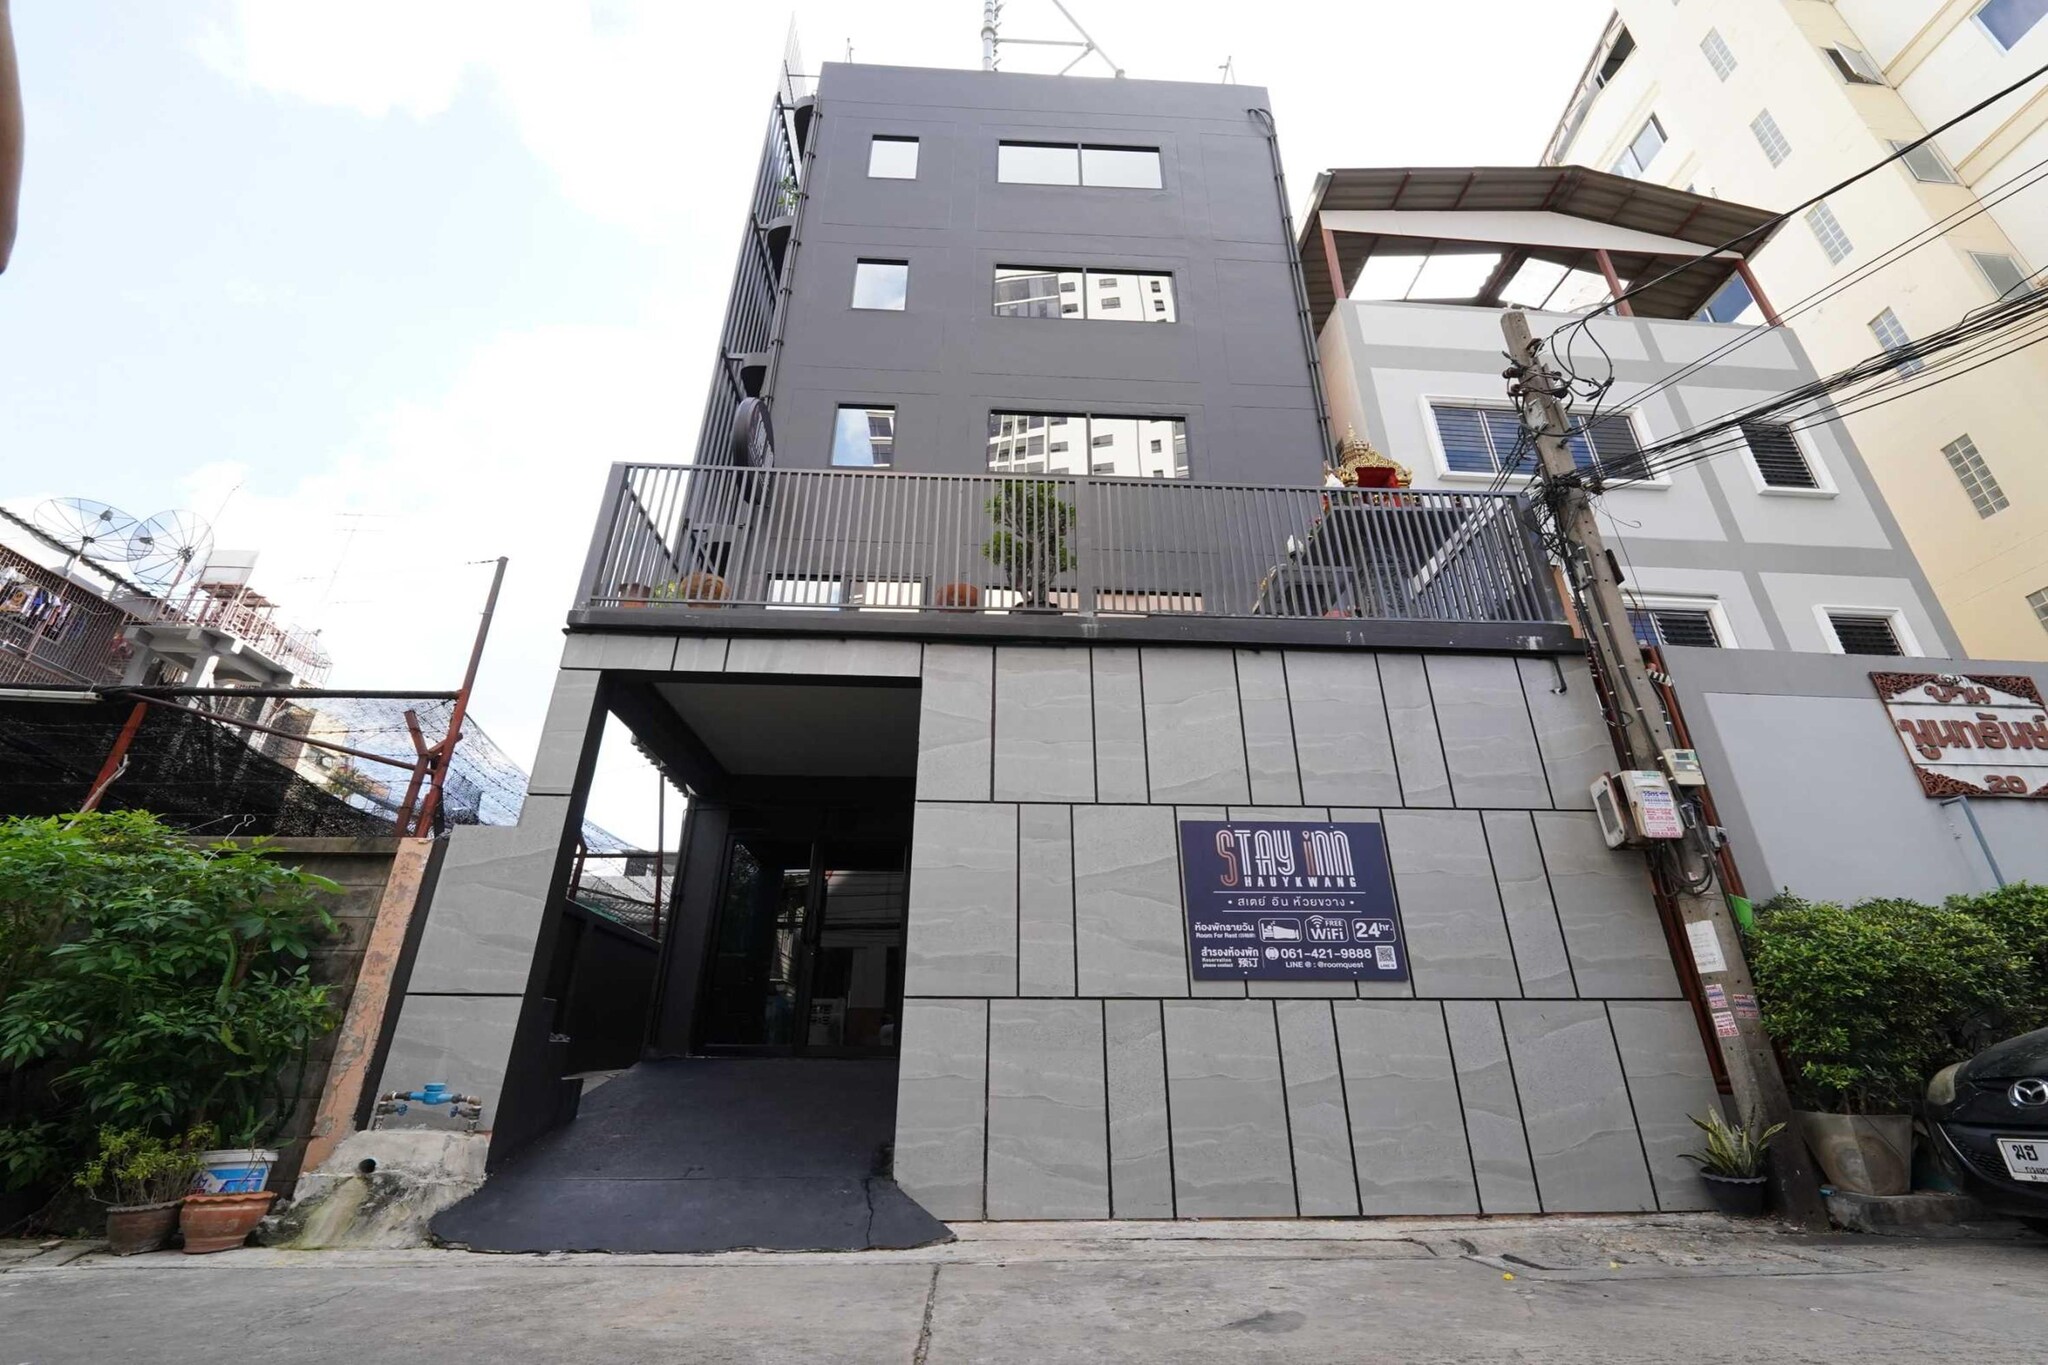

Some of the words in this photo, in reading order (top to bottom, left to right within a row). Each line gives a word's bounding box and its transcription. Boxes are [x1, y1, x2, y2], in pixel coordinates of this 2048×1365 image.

[1984, 774, 2028, 794] 20
[1244, 876, 1357, 888] HAUYKWANG
[1237, 895, 1266, 907] สเตย์
[1293, 895, 1346, 907] ห้วยขวาง
[1194, 921, 1255, 932] ห้องพักรายวัน
[1310, 927, 1344, 940] WiFi
[1201, 946, 1259, 957] สำรองห้องพัก
[1280, 948, 1372, 959] 061-421-9888
